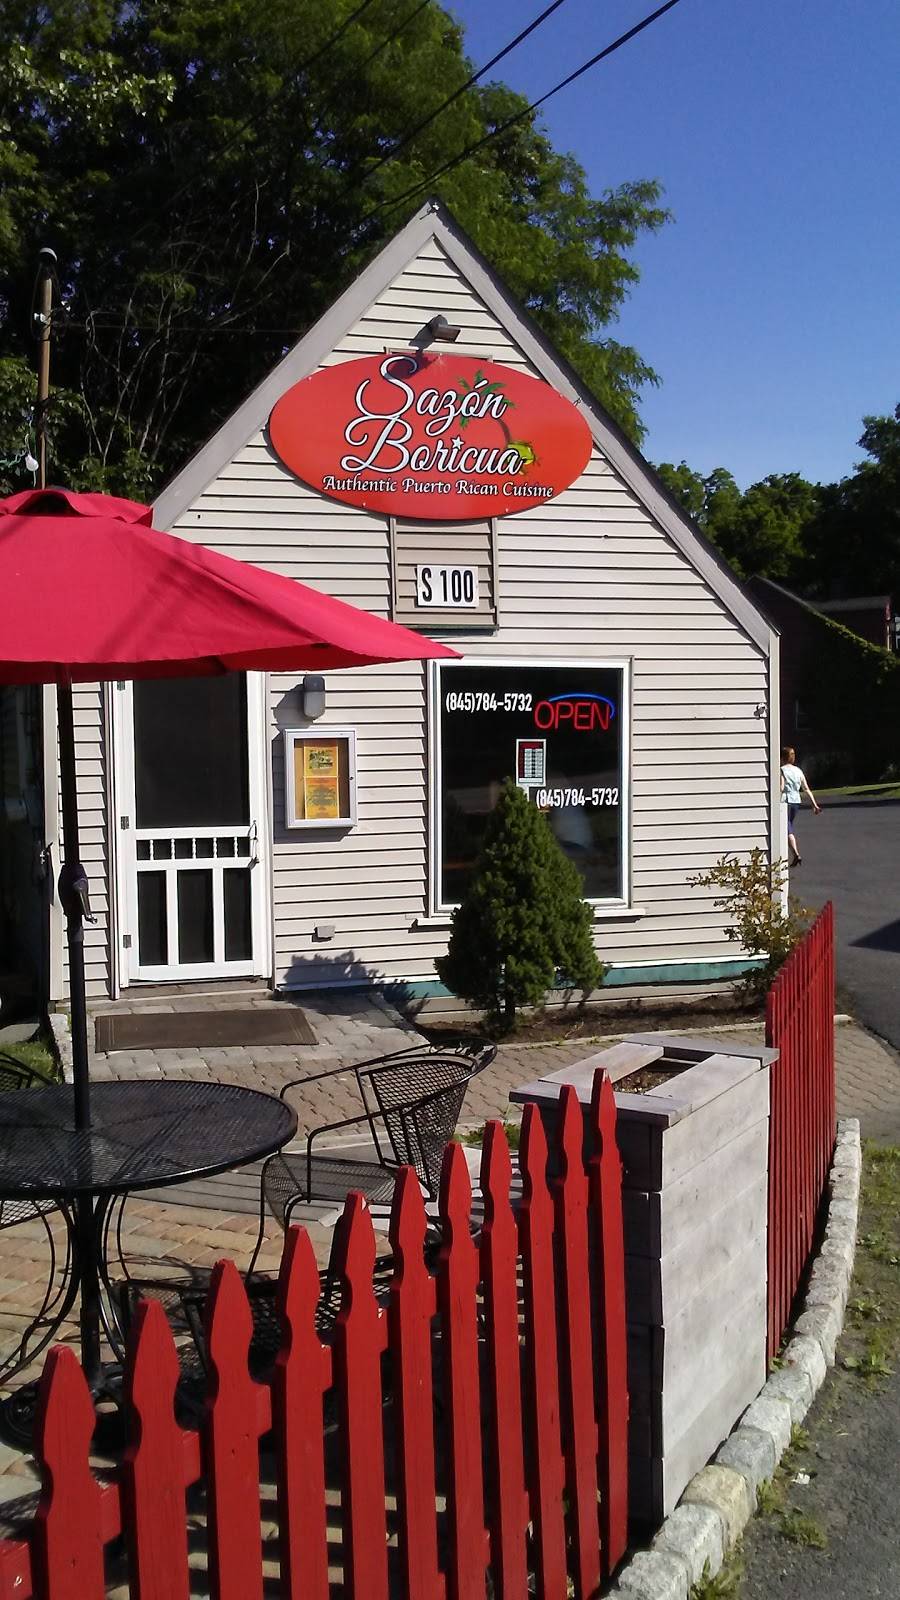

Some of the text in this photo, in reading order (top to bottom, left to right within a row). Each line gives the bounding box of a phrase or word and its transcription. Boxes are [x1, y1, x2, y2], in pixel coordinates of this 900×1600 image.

[355, 356, 508, 436] Sazón
[340, 413, 524, 476] Boricua
[323, 474, 554, 498] Authentic Puerto Rican Cuisine
[421, 567, 474, 602] S 100
[446, 692, 533, 713] (845)784-5732
[534, 700, 610, 730] OPEN
[535, 788, 619, 808] (845)784-5732
